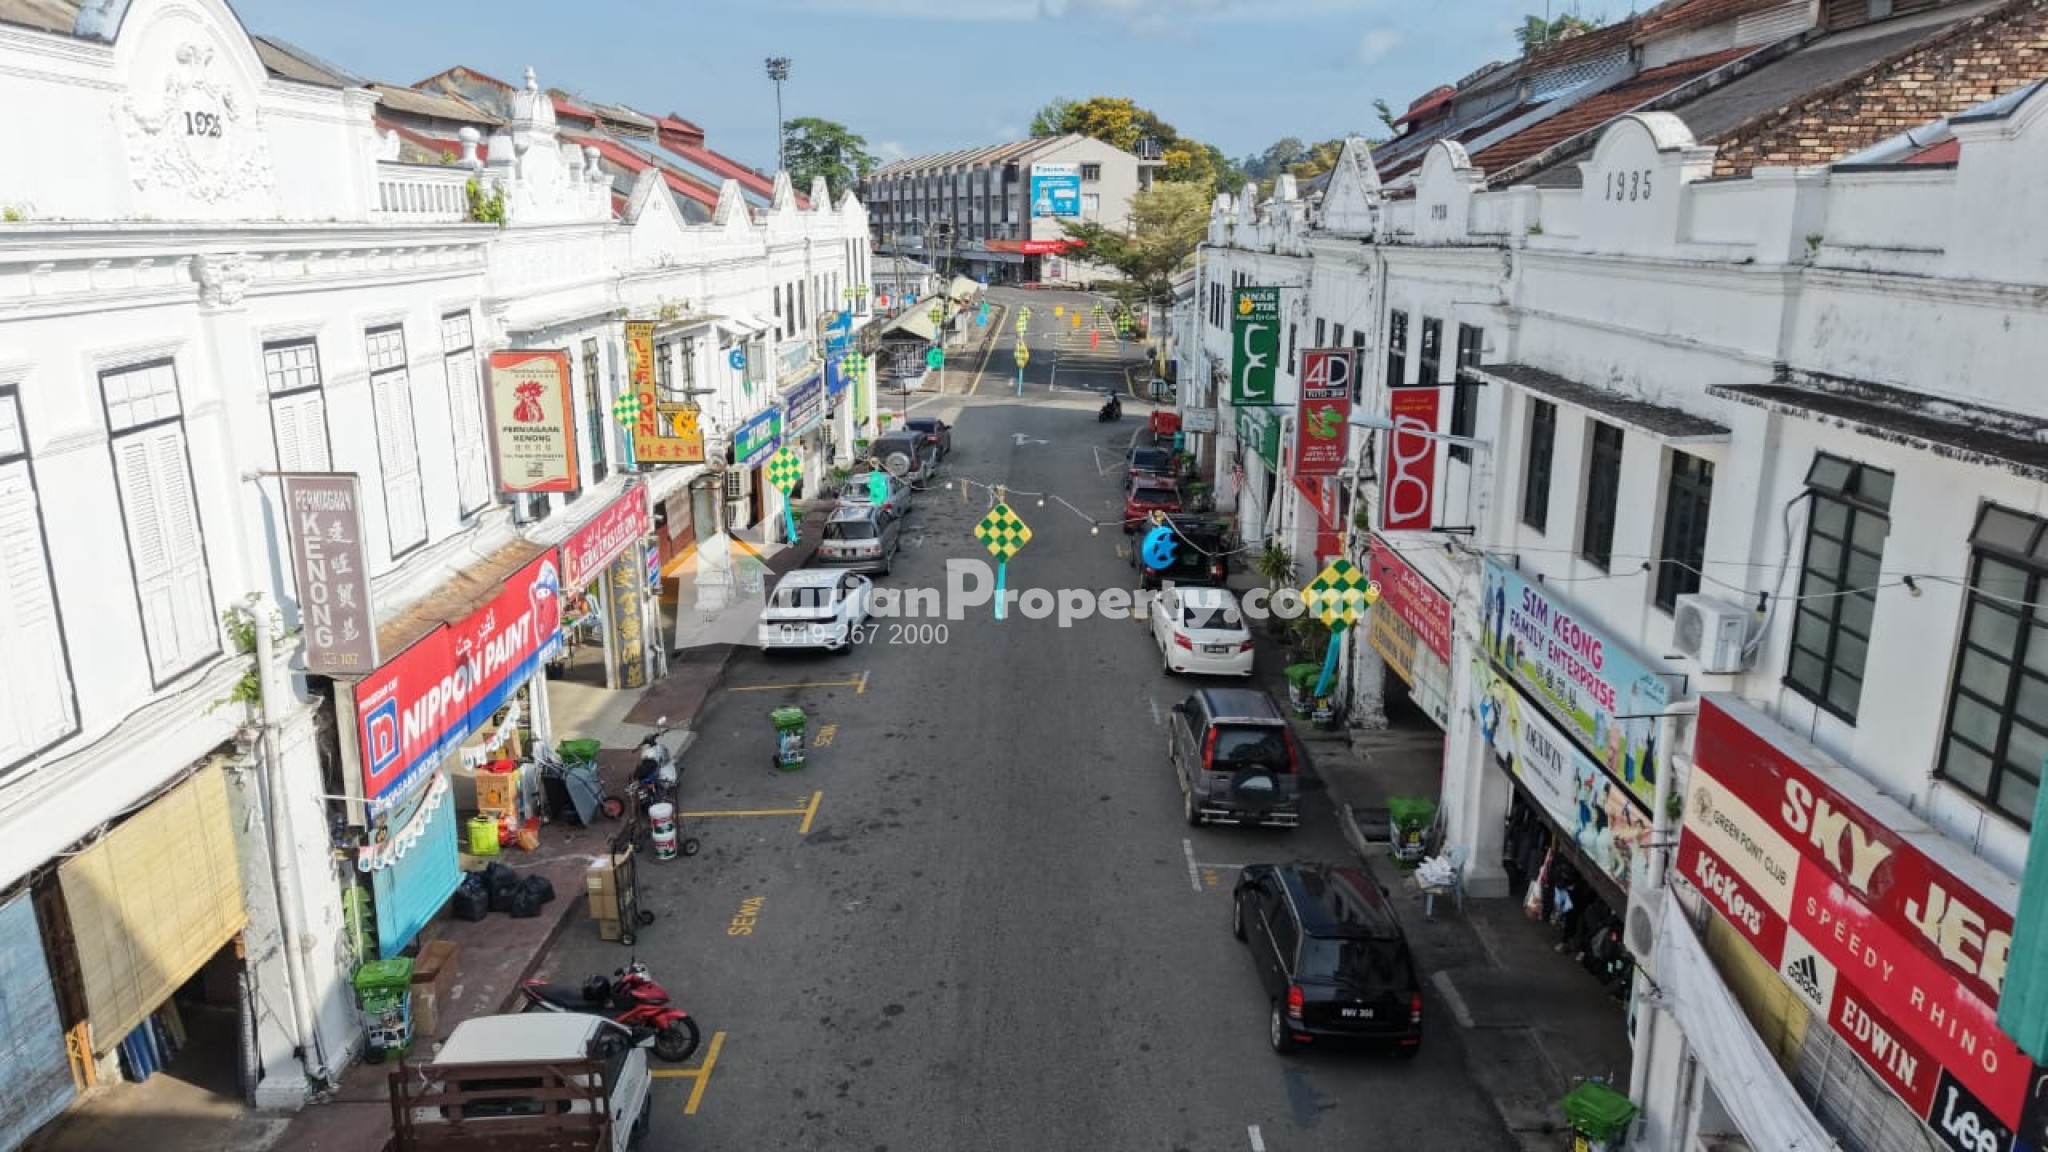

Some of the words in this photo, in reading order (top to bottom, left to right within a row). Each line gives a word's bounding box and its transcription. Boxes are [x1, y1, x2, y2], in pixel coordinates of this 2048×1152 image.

[1606, 170, 1652, 202] 1935
[1306, 356, 1348, 387] 4D
[302, 512, 334, 649] KENONG
[1510, 608, 1545, 651] FAMILY
[1548, 639, 1616, 713] ENTERPRISE
[1522, 586, 1548, 628] SIM
[1553, 609, 1603, 670] KEONG
[402, 650, 481, 750] NIPPON
[484, 610, 532, 679] PAINT
[1713, 810, 1740, 841] GREEN
[1740, 832, 1764, 861] POINT
[1765, 856, 1787, 886] CLUB
[1782, 778, 1892, 895] SKY
[727, 895, 768, 936] SEWA
[1787, 964, 1823, 1006] adidas
[1806, 897, 1894, 982] SPEEDY
[1910, 985, 1998, 1074] RHINO
[1941, 1085, 1998, 1152] Lee
